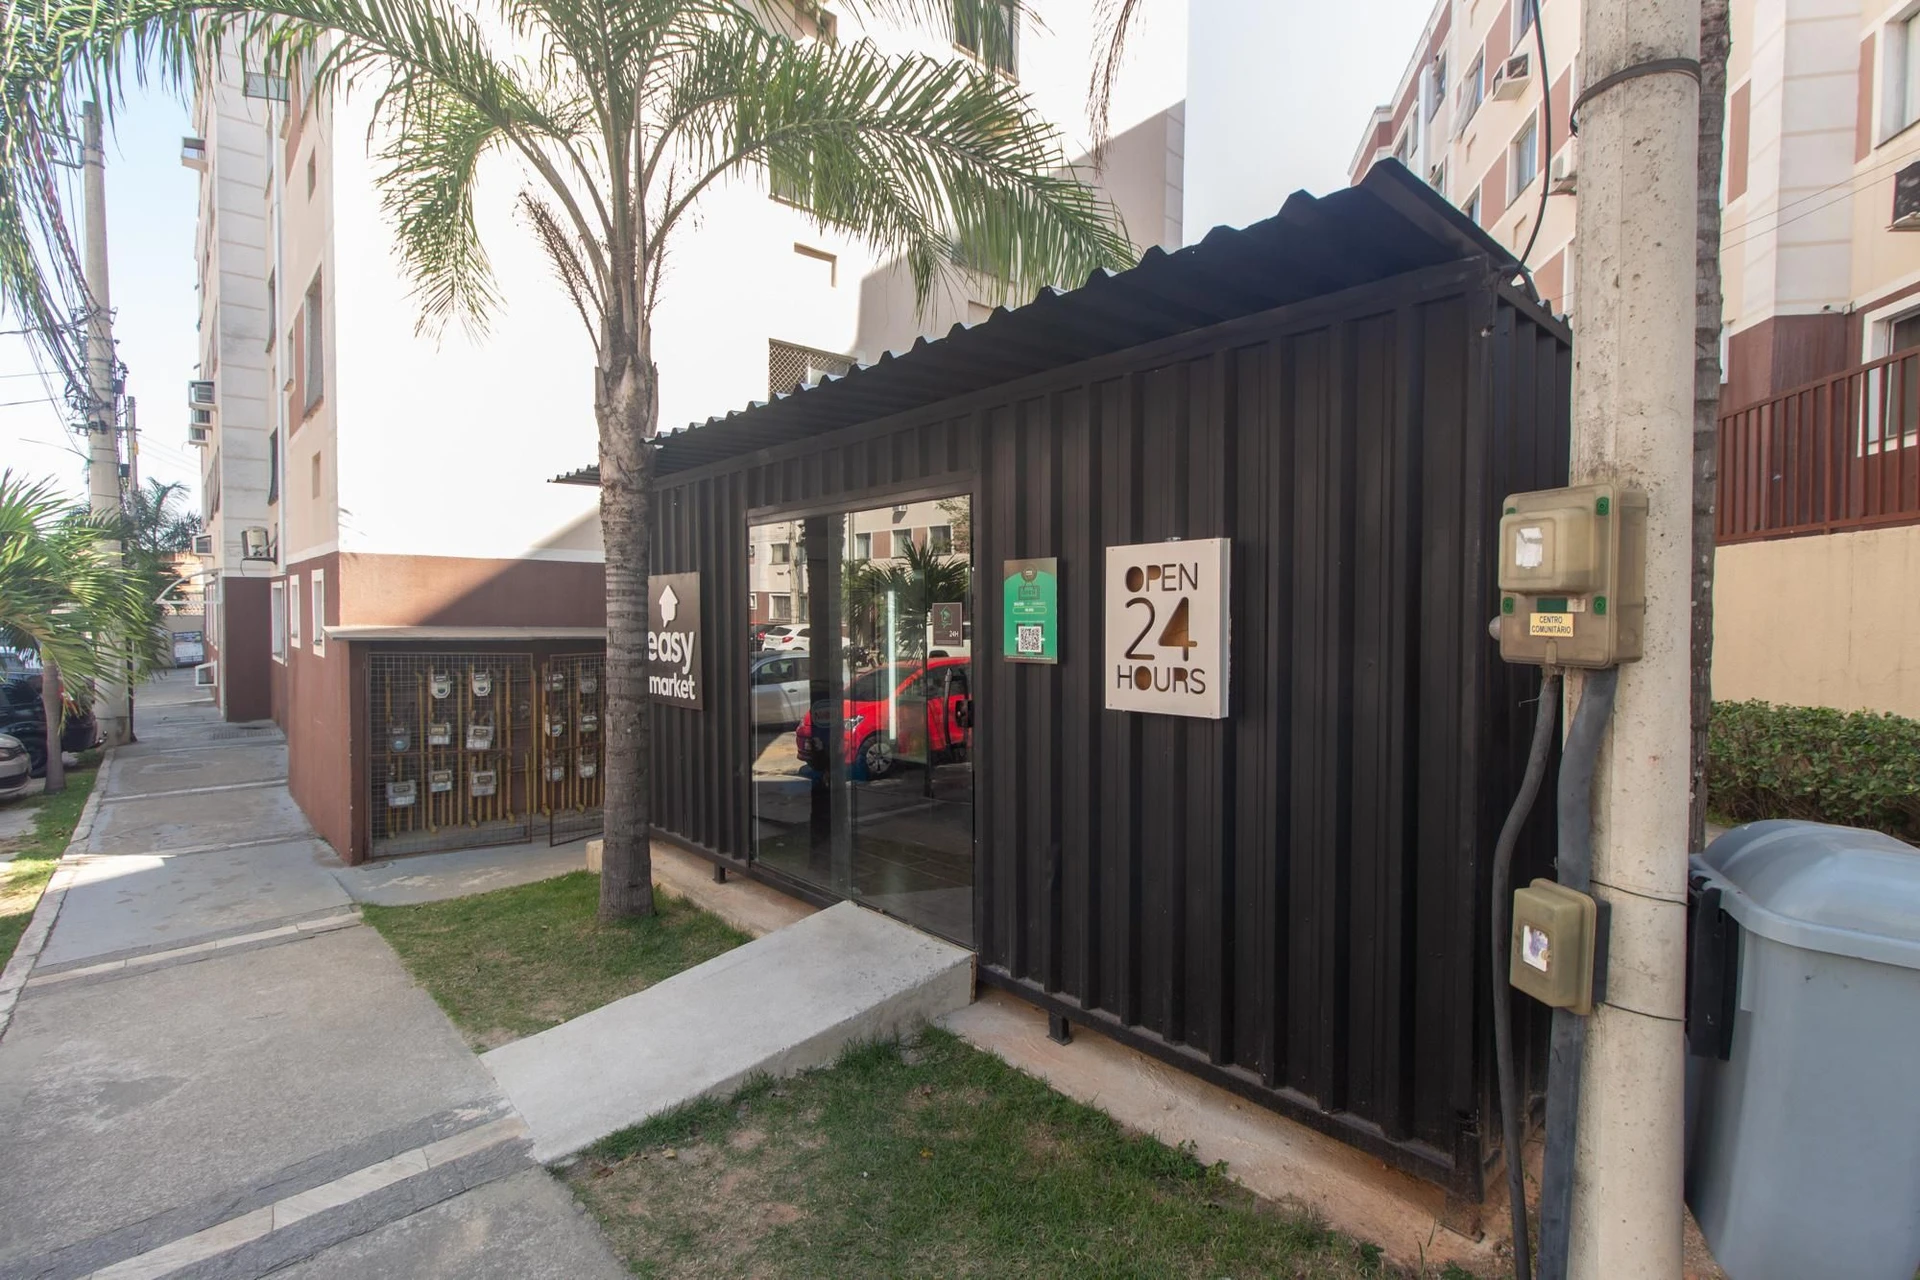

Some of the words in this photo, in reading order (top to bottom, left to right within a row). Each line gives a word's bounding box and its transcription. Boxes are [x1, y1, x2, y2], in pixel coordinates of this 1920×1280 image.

[1125, 562, 1198, 593] OPEN
[1124, 596, 1198, 662] 24
[1539, 615, 1563, 624] CENTRO
[647, 631, 694, 675] easy
[649, 672, 696, 700] market
[1117, 664, 1206, 694] HOURS
